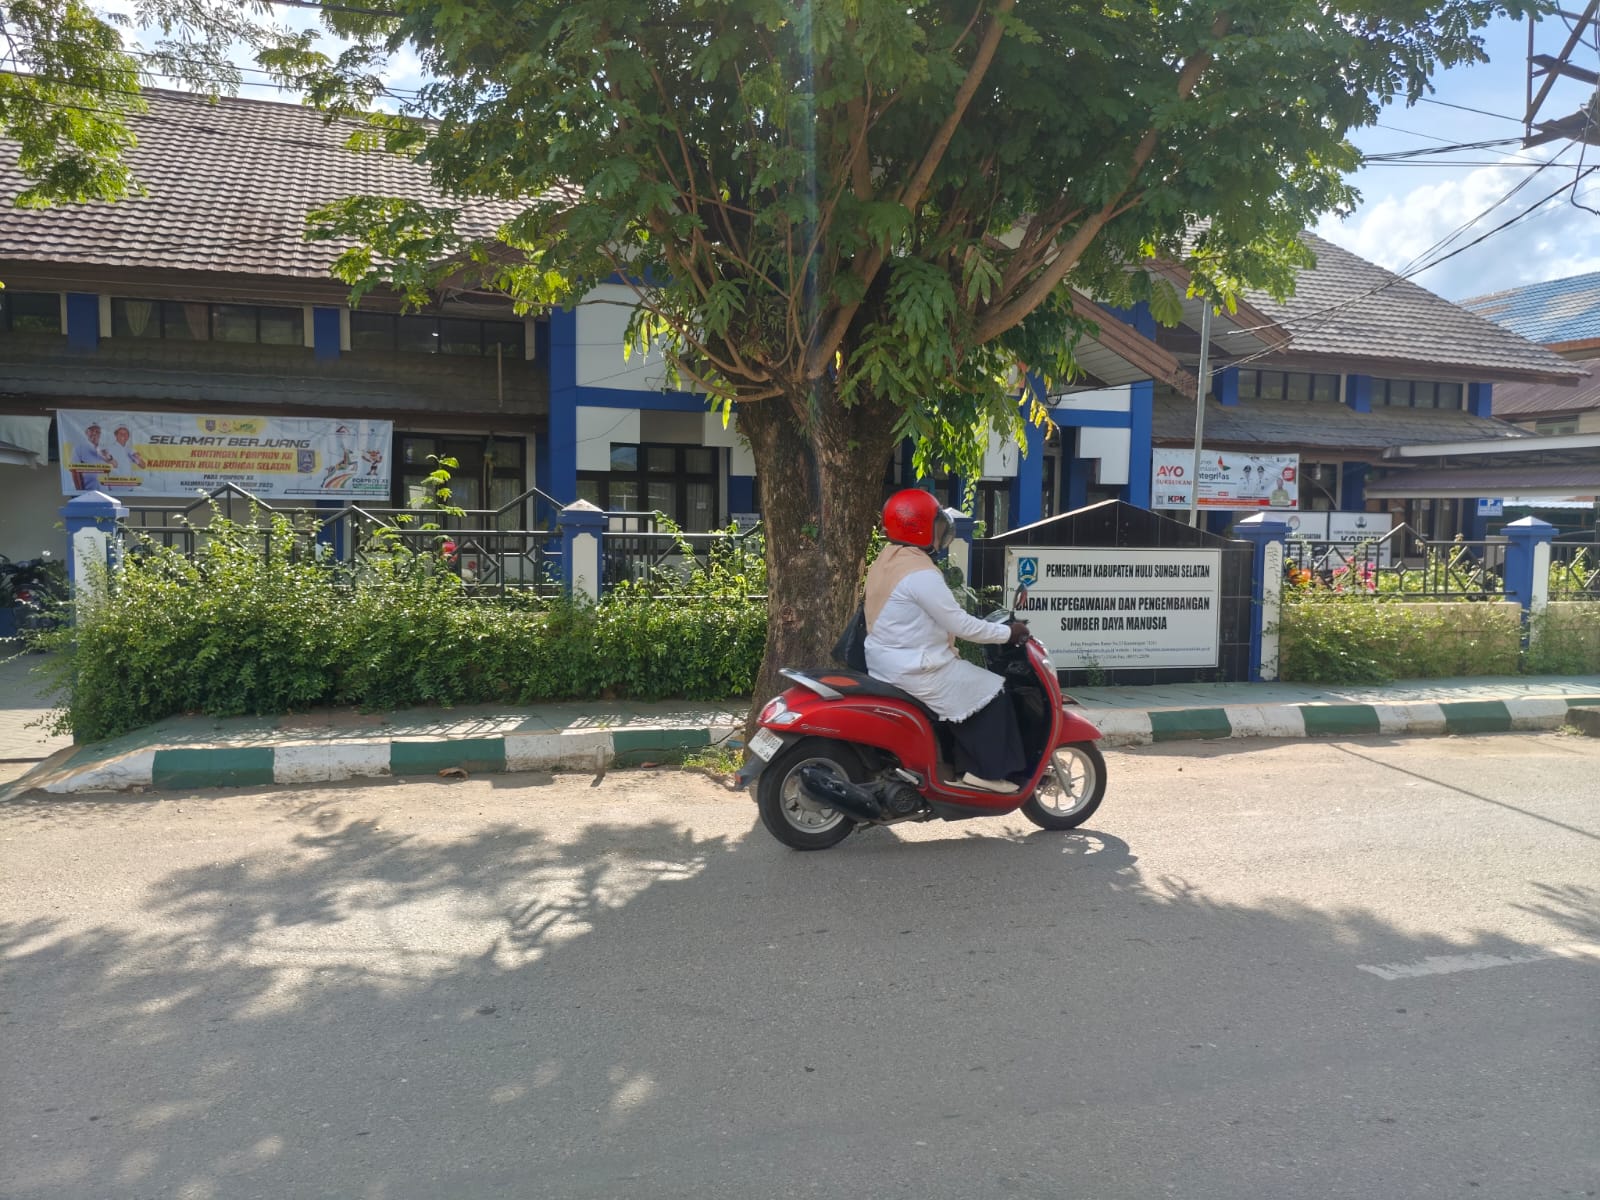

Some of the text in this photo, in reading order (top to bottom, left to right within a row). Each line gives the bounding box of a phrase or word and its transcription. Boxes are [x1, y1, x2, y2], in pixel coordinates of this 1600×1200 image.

[149, 435, 310, 448] SELAMAT BERJUANG
[190, 449, 237, 458] KONTINGEN
[239, 450, 279, 460] PORPROV
[147, 459, 291, 471] KABUPATEN HULU SUNGAI SELATAN
[1156, 465, 1184, 478] AYO
[1199, 472, 1230, 481] ntegritas
[1167, 495, 1186, 503] KPK
[1046, 564, 1210, 578] PEMERINTAH KABUPATEN HULU SUNGAI SELATAN
[1051, 597, 1117, 611] KEPEGAWAIAN
[1118, 597, 1136, 611] DAN
[1138, 597, 1210, 610] PENGEMBANGAN
[1060, 616, 1167, 631] SUMBER DAYA MANUSIA
